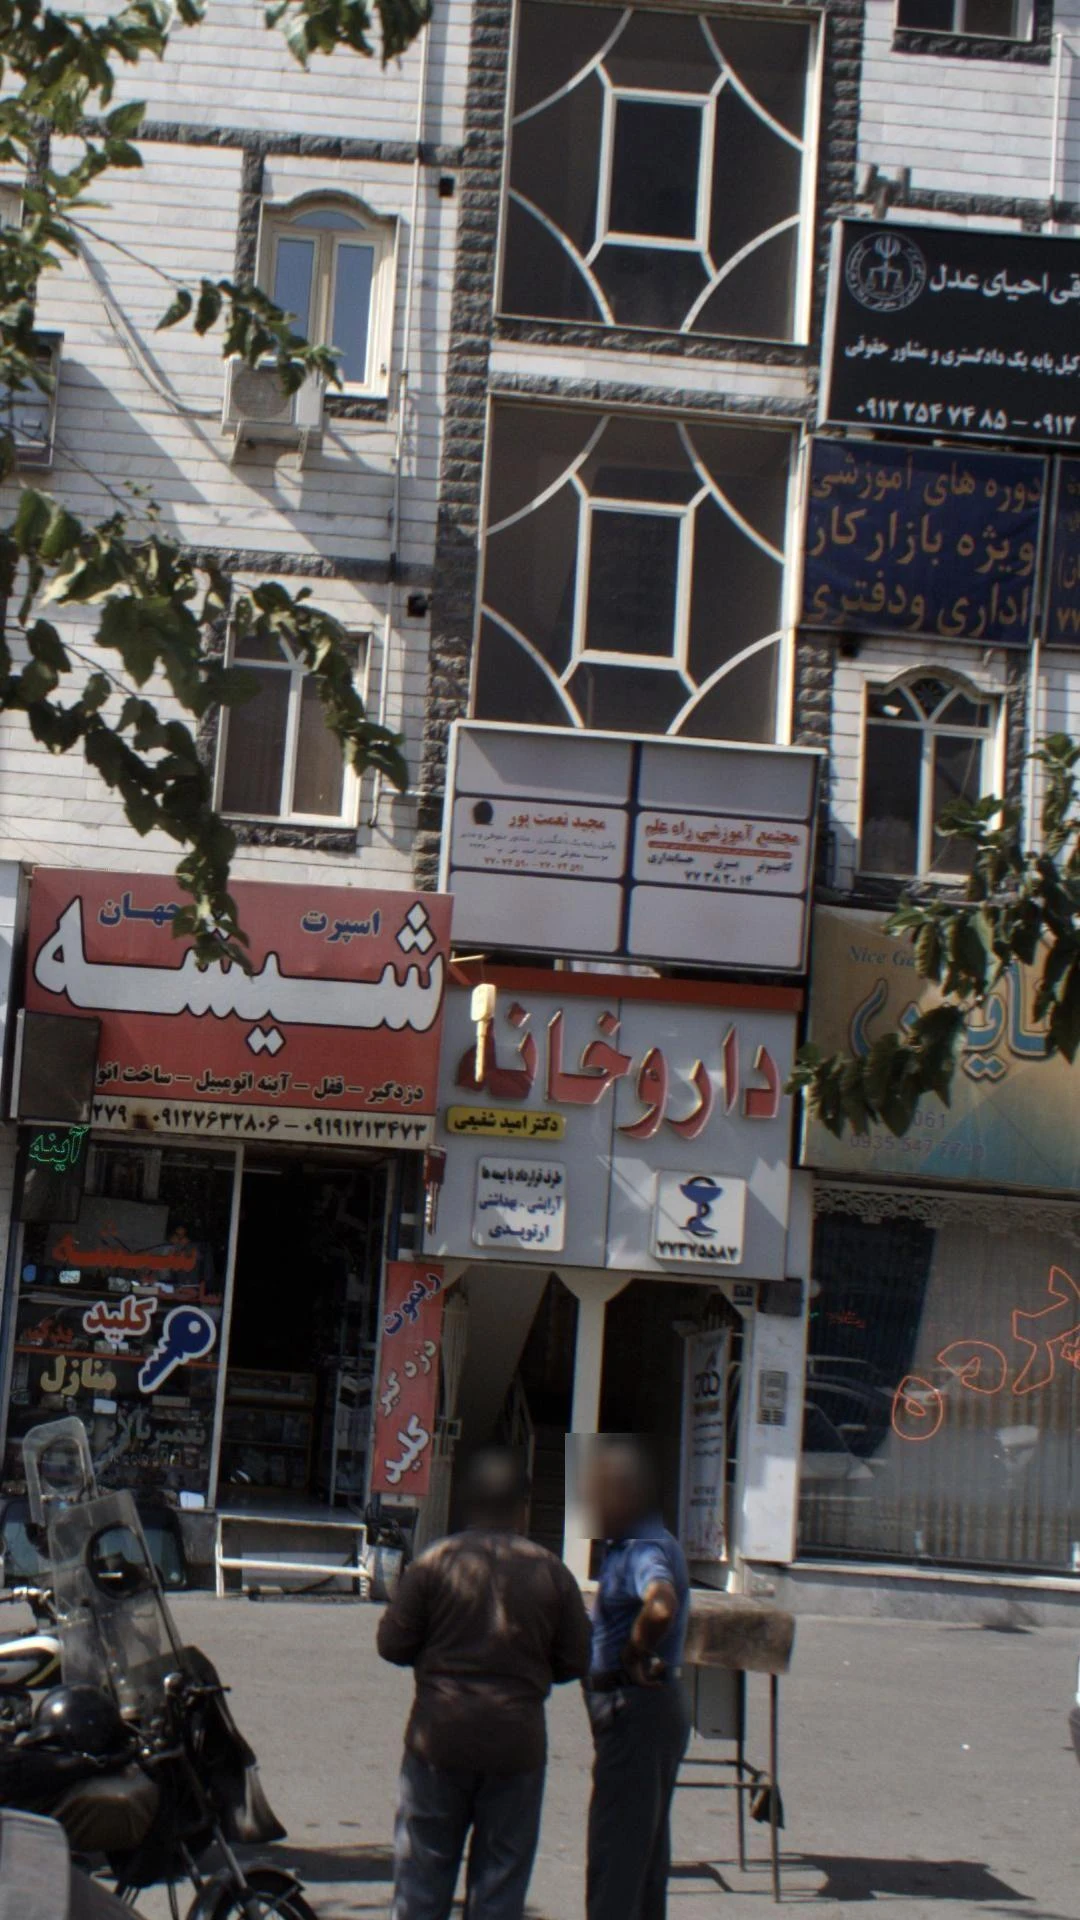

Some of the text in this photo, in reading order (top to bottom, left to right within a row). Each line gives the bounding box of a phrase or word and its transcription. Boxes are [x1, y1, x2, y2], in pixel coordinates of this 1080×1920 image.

[929, 263, 979, 292] عدل
[981, 268, 1048, 301] احیای
[844, 334, 889, 360] حقوقی
[890, 341, 929, 363] مشاور
[930, 349, 939, 366] و
[940, 347, 1005, 368] دادگستری
[1006, 350, 1029, 373] یک
[1030, 352, 1053, 376] پایه
[923, 460, 976, 506] های
[986, 473, 1041, 513] دوره
[957, 524, 1035, 576] ویژه
[937, 582, 1030, 637] اداری
[508, 811, 606, 833] مجید نعمت پور
[645, 817, 799, 849] مجتمع آموزشی راه علم
[301, 907, 382, 943] اسپرت
[33, 895, 445, 1057] شیشه
[121, 1063, 172, 1085] ساخت
[195, 1069, 255, 1096] اتومبیل
[256, 1073, 290, 1097] آینه
[454, 1001, 780, 1140] داروخانه
[313, 1076, 345, 1100] قفل
[366, 1080, 425, 1107] دزدگیر
[152, 1106, 280, 1133] ۰۹۱۲۷۶۳۲۸۰۶
[304, 1116, 427, 1142] ۰۹۱۹۱۲۱۳۴۷۳
[453, 1110, 558, 1136] دکتر امید شفیعی
[29, 1124, 90, 1171] آینه
[479, 1192, 517, 1212] بهداشتی
[527, 1194, 562, 1216] آرایشی
[82, 1295, 158, 1343] کلید
[384, 1272, 442, 1337] ریموت
[39, 1355, 117, 1396] منازل
[385, 1413, 430, 1485] کلید
